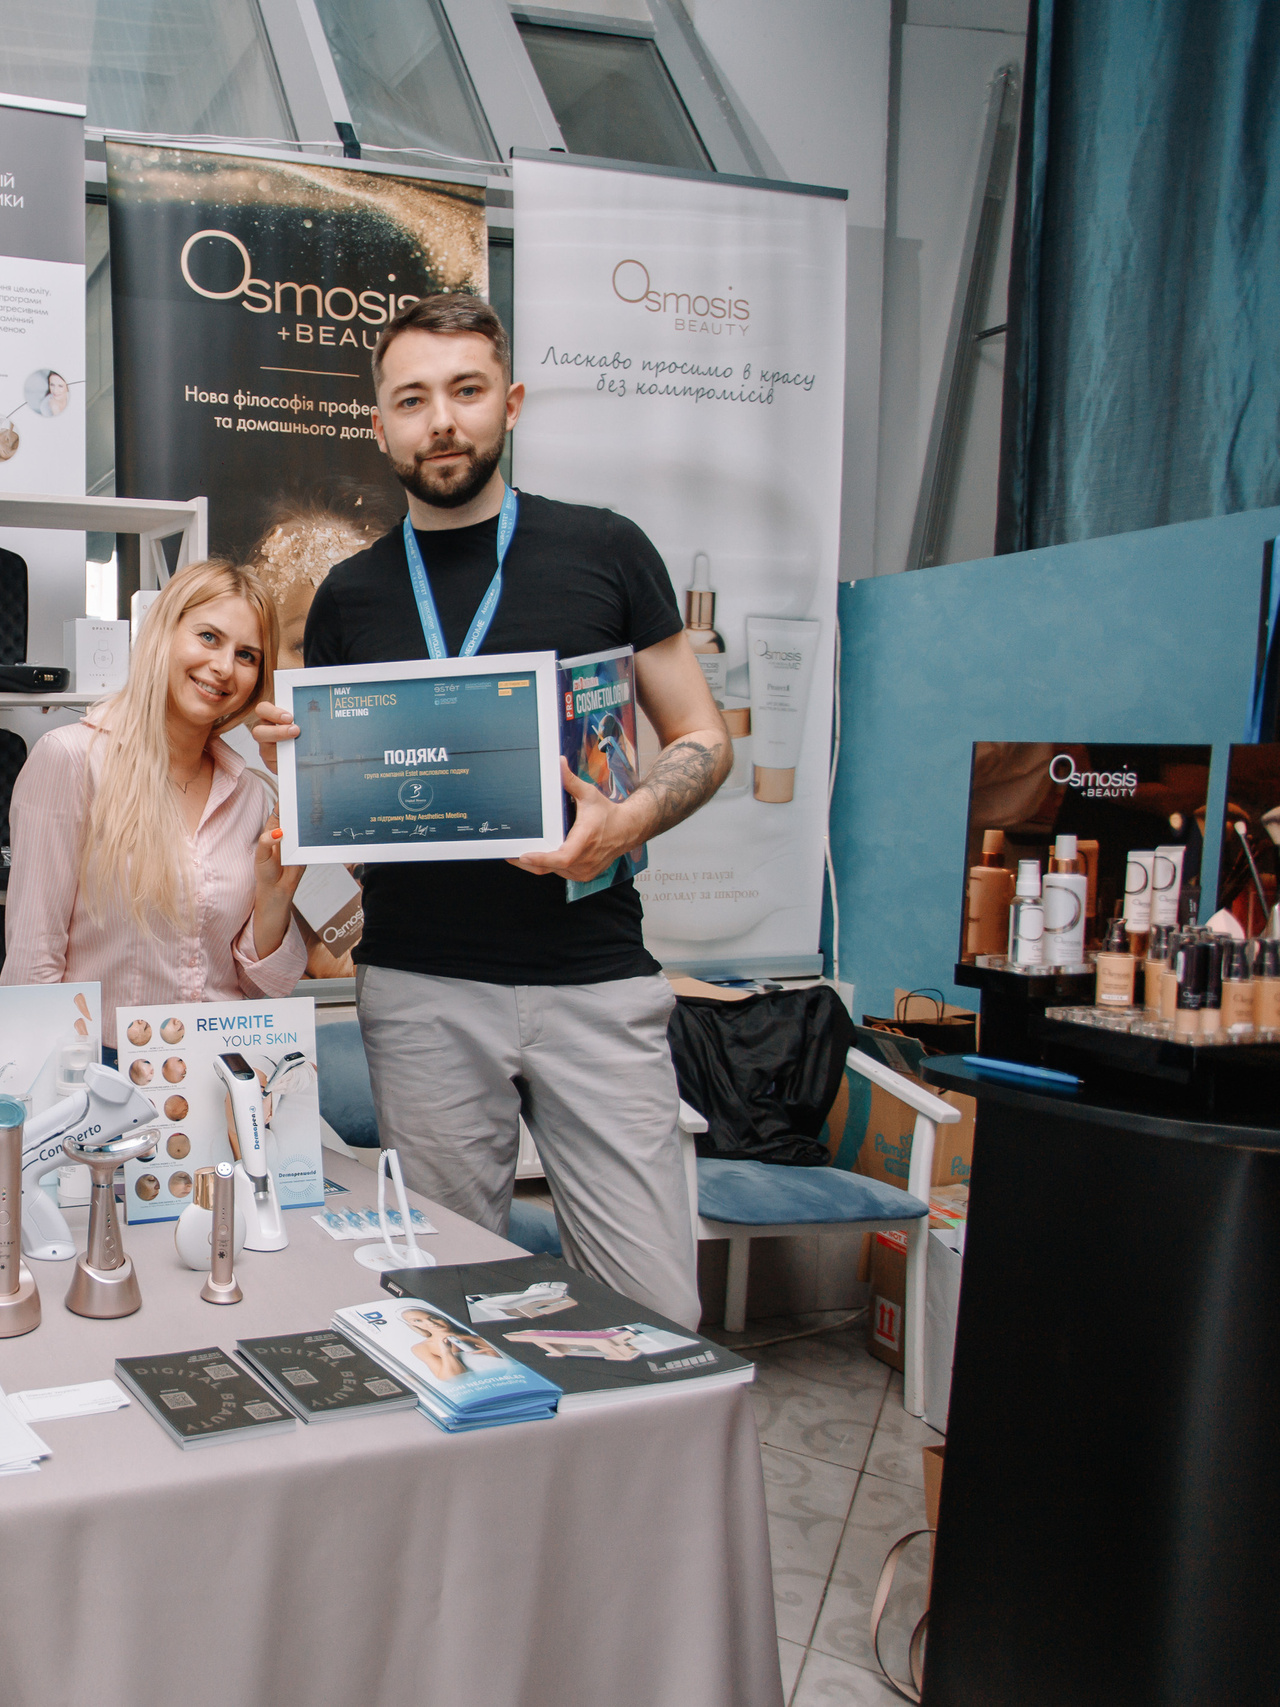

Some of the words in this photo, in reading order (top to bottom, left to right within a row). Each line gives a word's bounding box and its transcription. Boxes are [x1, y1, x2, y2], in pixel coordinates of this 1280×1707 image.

[612, 259, 750, 320] Osmosis
[674, 318, 750, 337] BEAUTY
[540, 346, 632, 370] Ласкаво
[641, 357, 733, 384] просимо
[743, 363, 751, 380] в
[760, 369, 816, 392] красу
[596, 372, 626, 397] без
[635, 383, 775, 405] компромісів
[184, 385, 229, 406] Нова
[233, 389, 314, 415] філософія
[214, 415, 233, 430] та
[236, 417, 336, 438] домашнього
[754, 639, 802, 661] Osmosis
[333, 687, 351, 695] MAY
[334, 694, 397, 709] AESTHETICS
[334, 708, 369, 717] MEETING
[565, 694, 573, 718] PRO
[383, 747, 448, 766] ПОДЯКА
[1049, 754, 1137, 787] Osmosis
[1080, 788, 1136, 798] +BEAUTY
[417, 812, 444, 820] Aesthetics
[445, 812, 467, 820] Meeting
[655, 869, 689, 885] бренд
[692, 871, 699, 884] у
[702, 867, 734, 883] галузі
[652, 891, 697, 903] догляду
[700, 891, 711, 900] за
[714, 889, 759, 902] шкірою
[196, 1014, 274, 1032] REWRITE
[222, 1034, 262, 1047] YOUR
[266, 1032, 297, 1045] SKIN
[39, 1124, 101, 1161] Conerto
[254, 1346, 340, 1368] DIGITAL
[134, 1366, 222, 1390] DIGITAL
[310, 1370, 357, 1407] BEAUTY
[186, 1392, 237, 1432] BEAUTY
